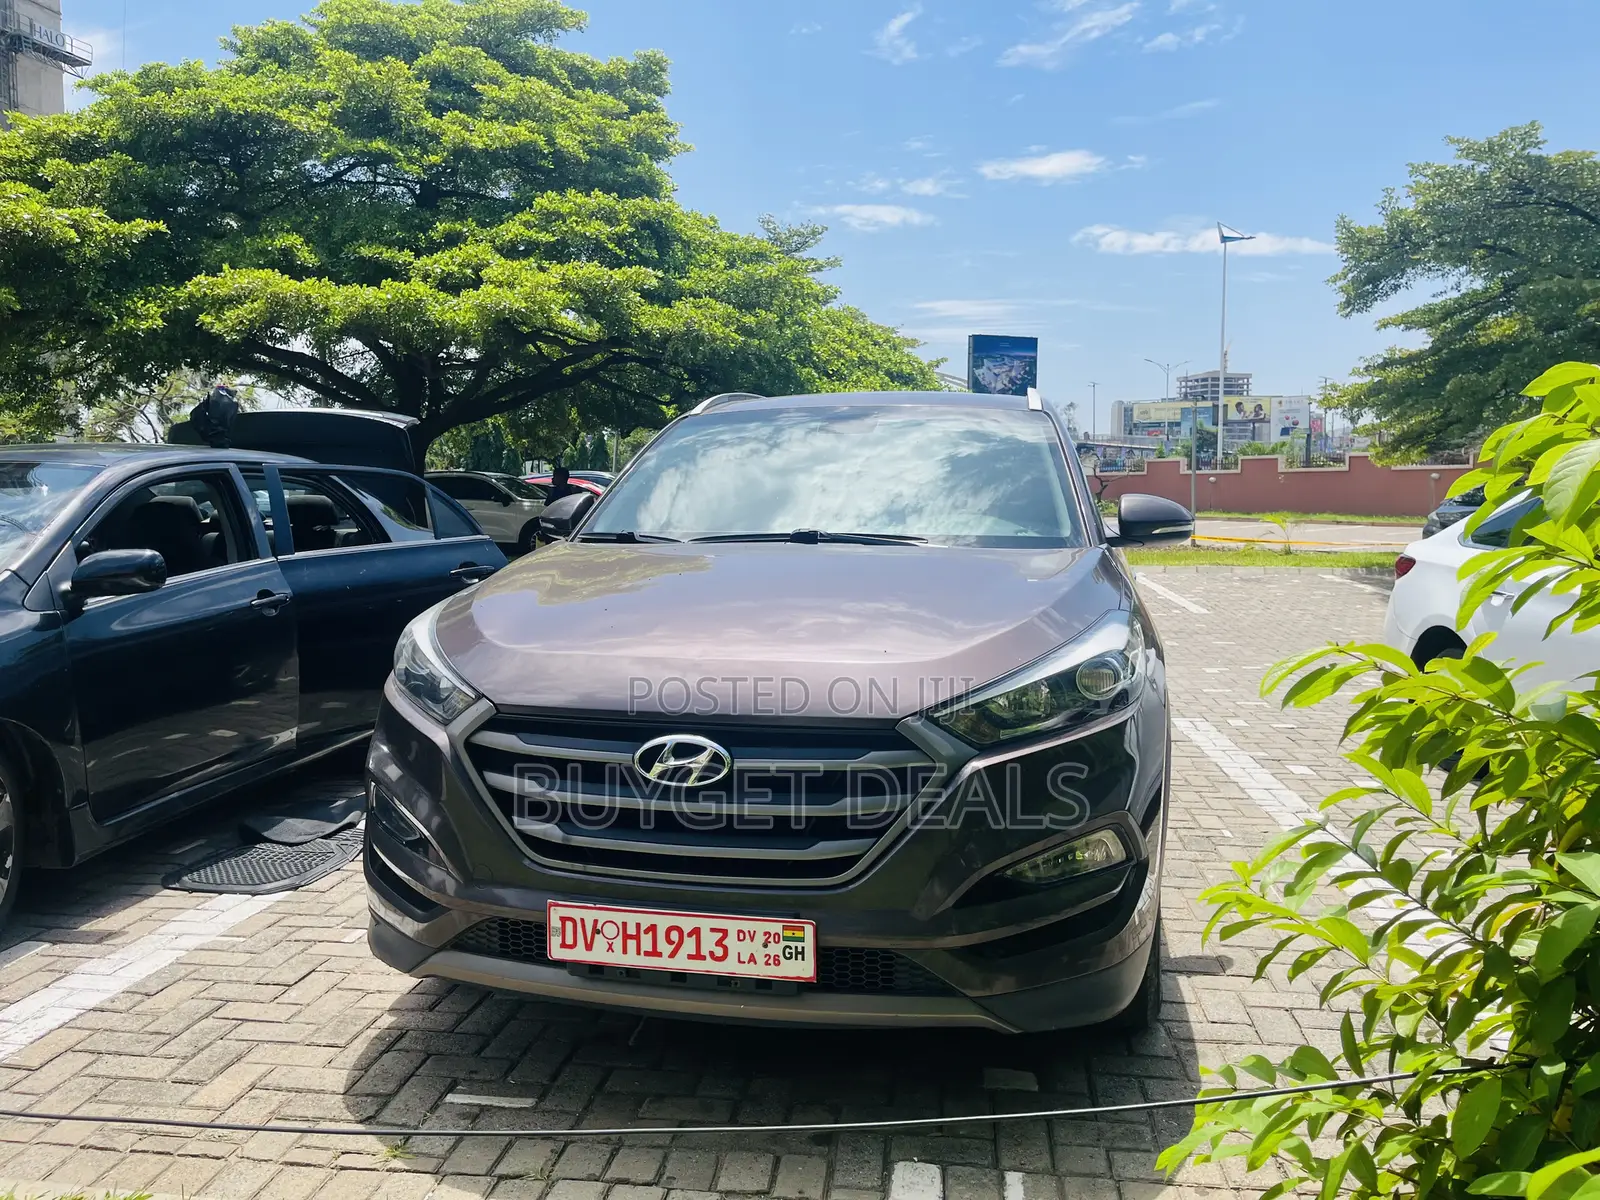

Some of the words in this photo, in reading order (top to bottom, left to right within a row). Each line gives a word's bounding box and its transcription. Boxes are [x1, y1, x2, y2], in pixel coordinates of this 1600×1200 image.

[33, 23, 66, 48] HALO
[559, 915, 599, 952] DV
[621, 920, 729, 963] H1913
[736, 928, 757, 943] DV
[762, 931, 781, 945] 20
[737, 951, 758, 965] LA
[763, 953, 782, 967] 26
[781, 944, 806, 962] GH
